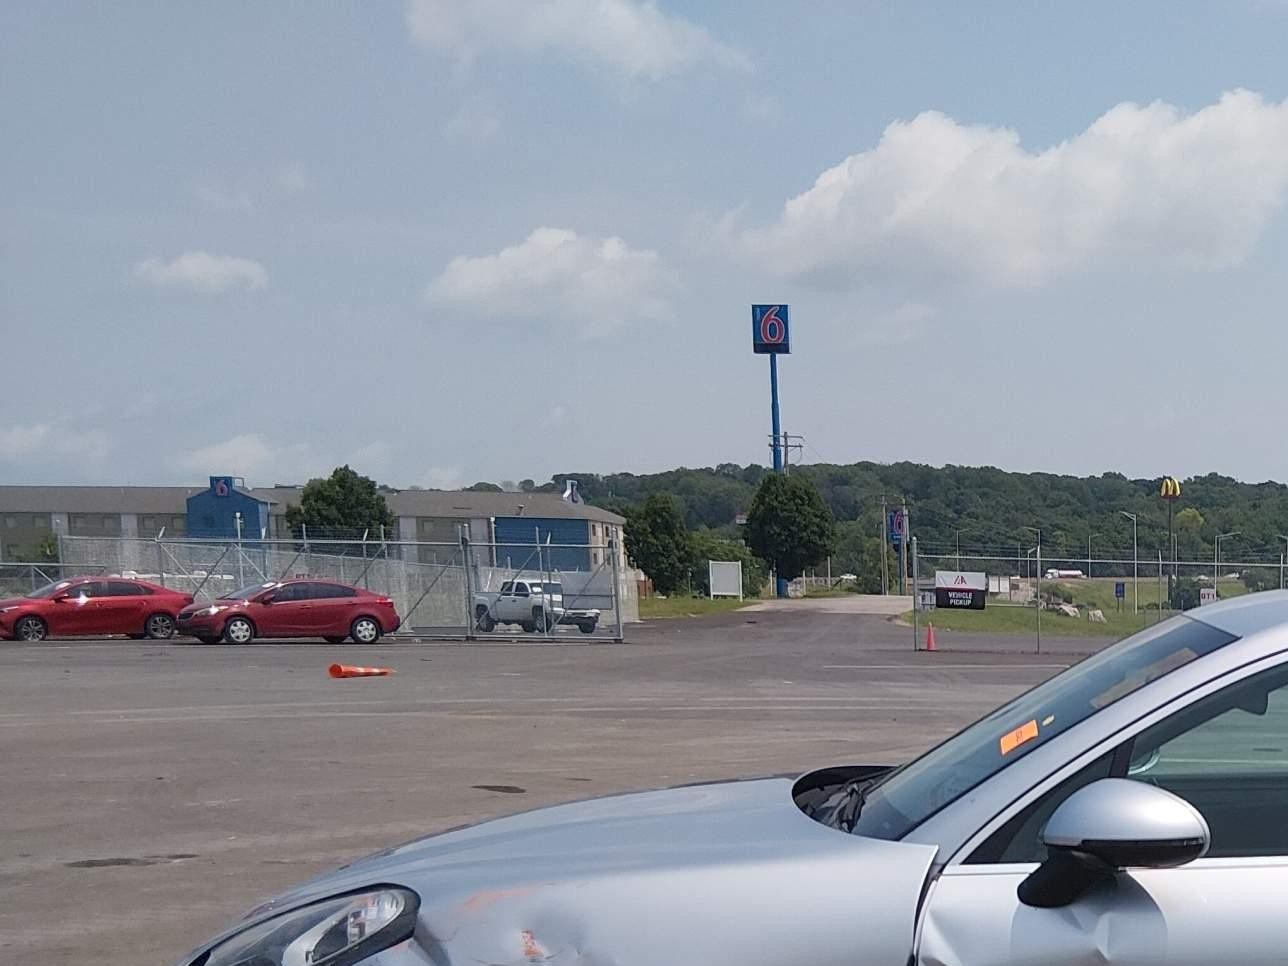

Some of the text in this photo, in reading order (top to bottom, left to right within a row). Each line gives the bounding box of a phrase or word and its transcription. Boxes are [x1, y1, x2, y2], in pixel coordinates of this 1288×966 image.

[761, 306, 785, 344] 6
[215, 480, 228, 496] 6
[948, 591, 972, 599] VEHICLE
